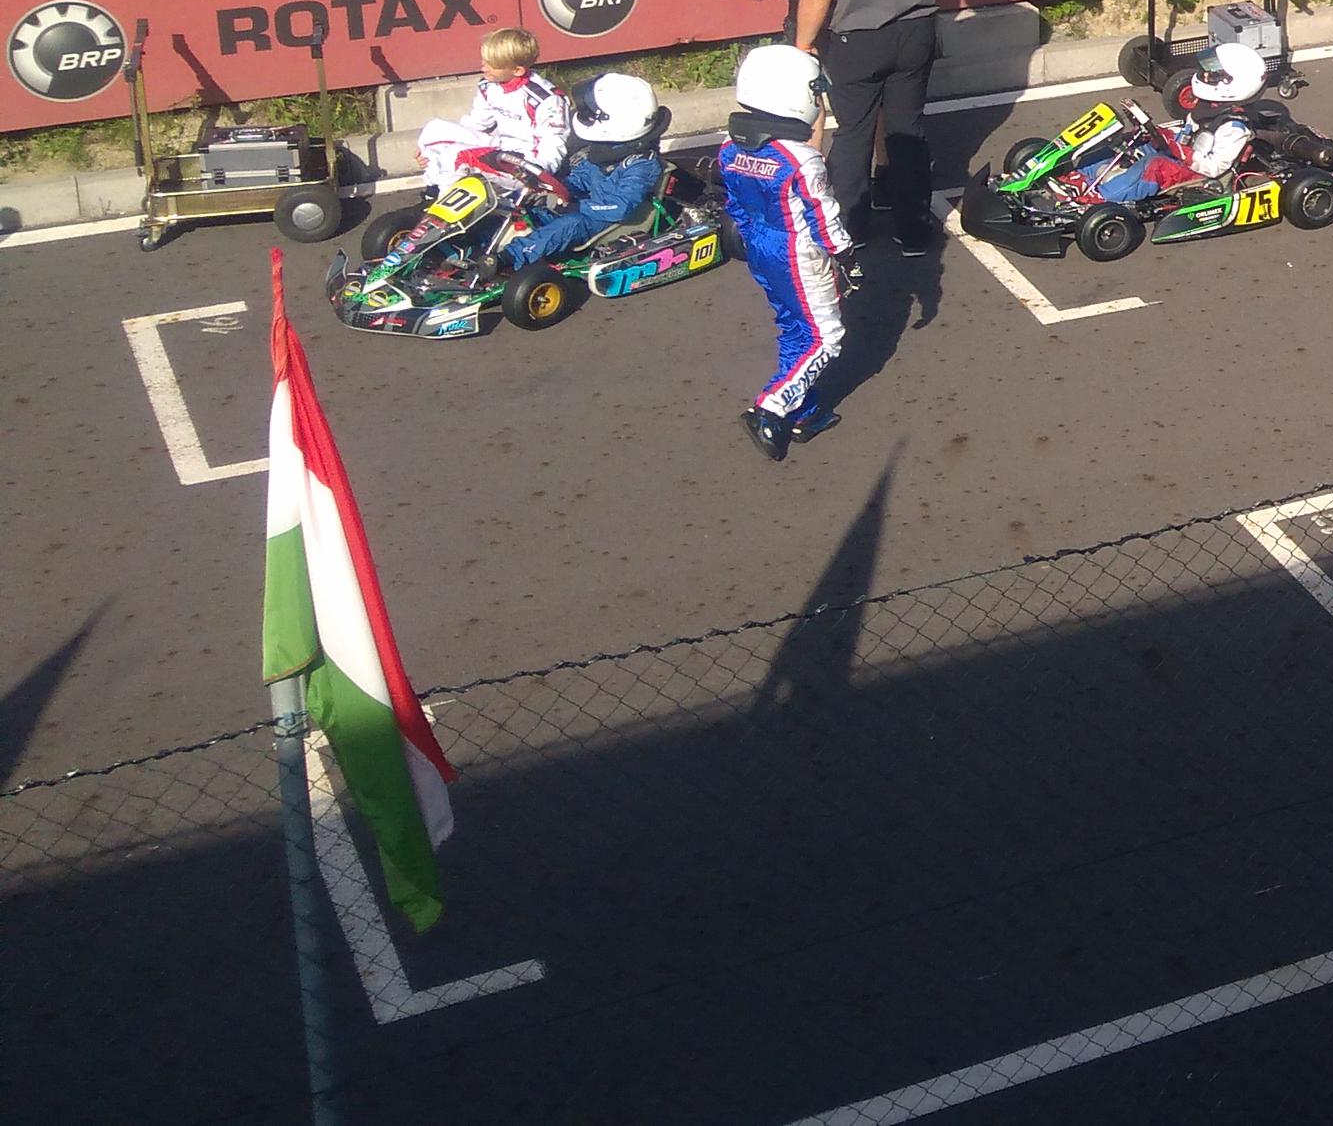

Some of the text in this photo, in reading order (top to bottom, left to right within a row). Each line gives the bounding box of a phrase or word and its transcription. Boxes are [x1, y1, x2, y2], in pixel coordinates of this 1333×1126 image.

[57, 48, 121, 71] BRP
[1067, 109, 1105, 138] 75
[435, 186, 479, 213] 101
[1244, 189, 1272, 223] 75
[694, 243, 714, 263] 101
